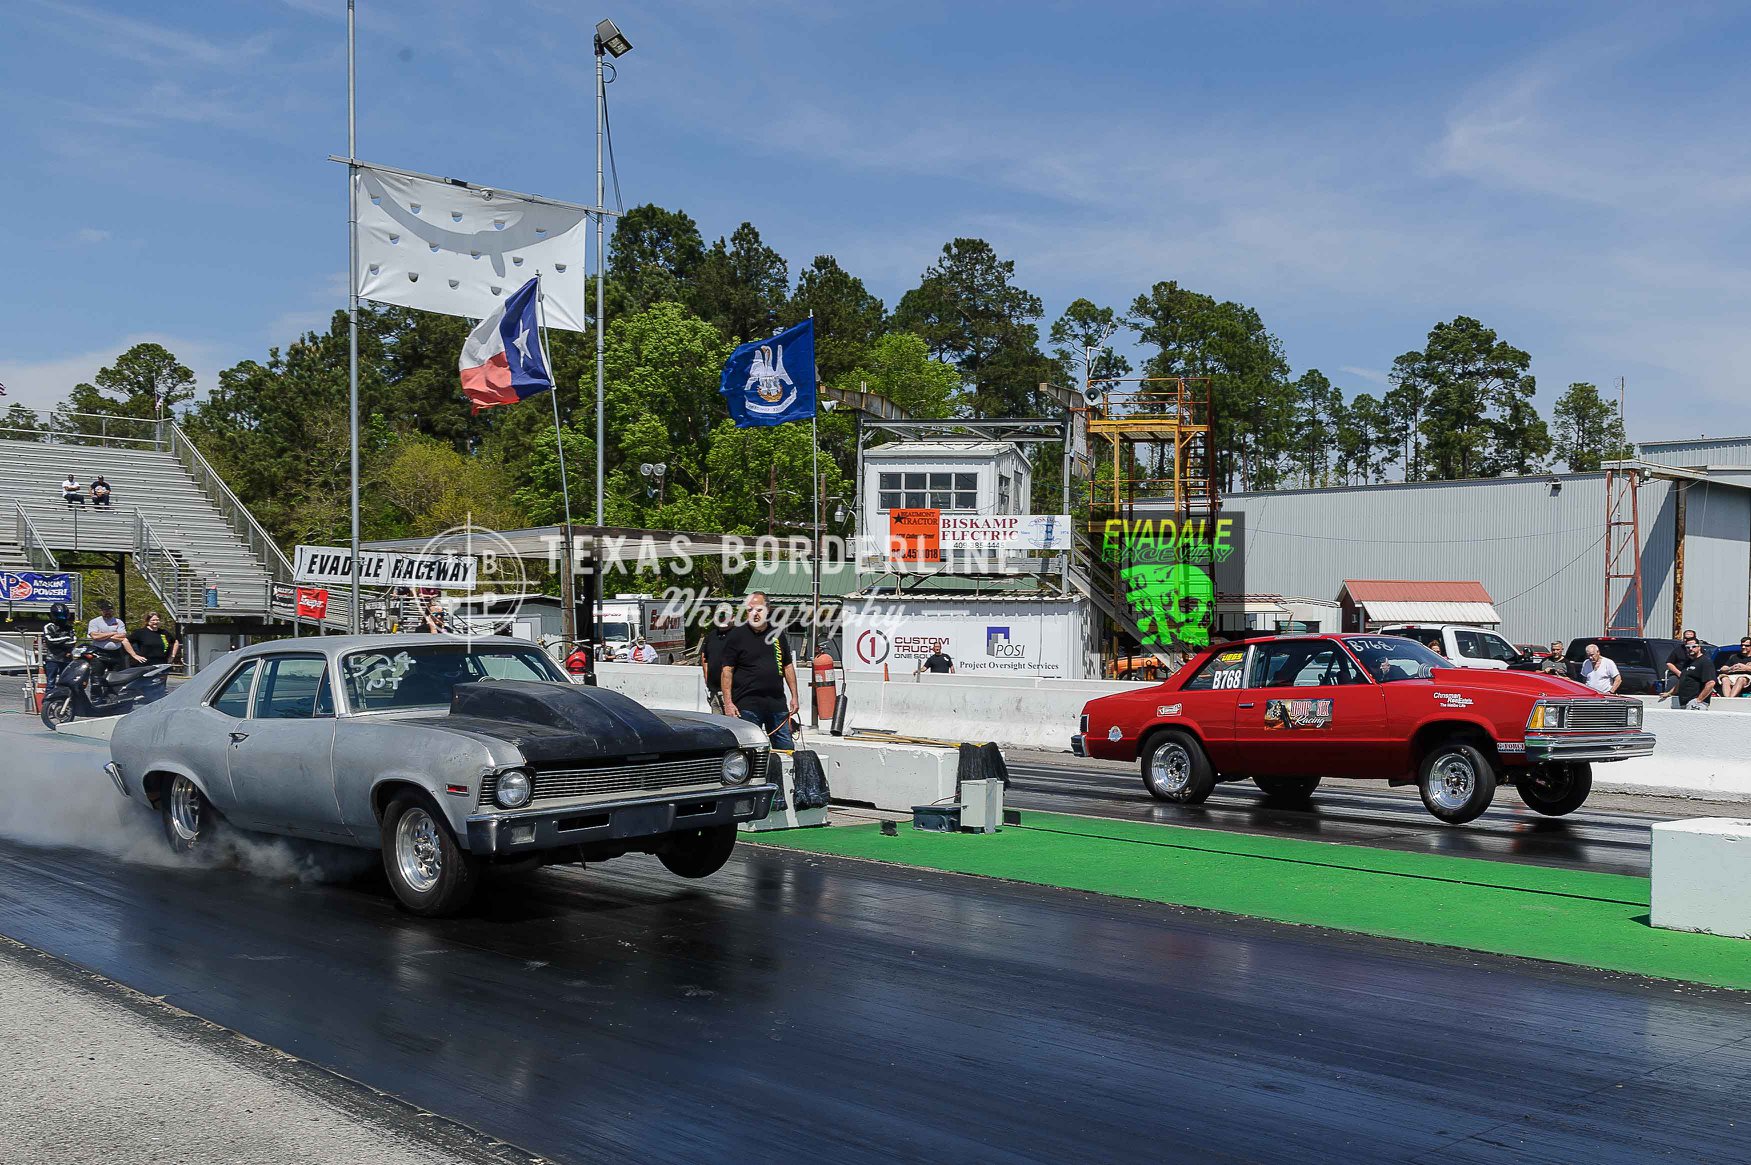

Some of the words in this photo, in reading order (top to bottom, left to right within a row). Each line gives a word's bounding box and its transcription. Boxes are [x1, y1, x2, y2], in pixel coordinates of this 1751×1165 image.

[902, 517, 938, 526] TRACTOR
[941, 518, 1018, 529] BISKAMP
[941, 530, 1019, 541] ELECTRIC
[307, 553, 384, 578] EVADLE
[391, 558, 474, 582] RACEWAY
[33, 588, 68, 596] POWER!
[894, 636, 950, 645] CUSTOM
[995, 644, 1026, 657] POSI
[959, 661, 987, 670] Project
[988, 661, 1026, 670] Oversight
[1027, 661, 1059, 670] Services
[1212, 670, 1242, 690] B768
[1294, 715, 1325, 729] Racing
